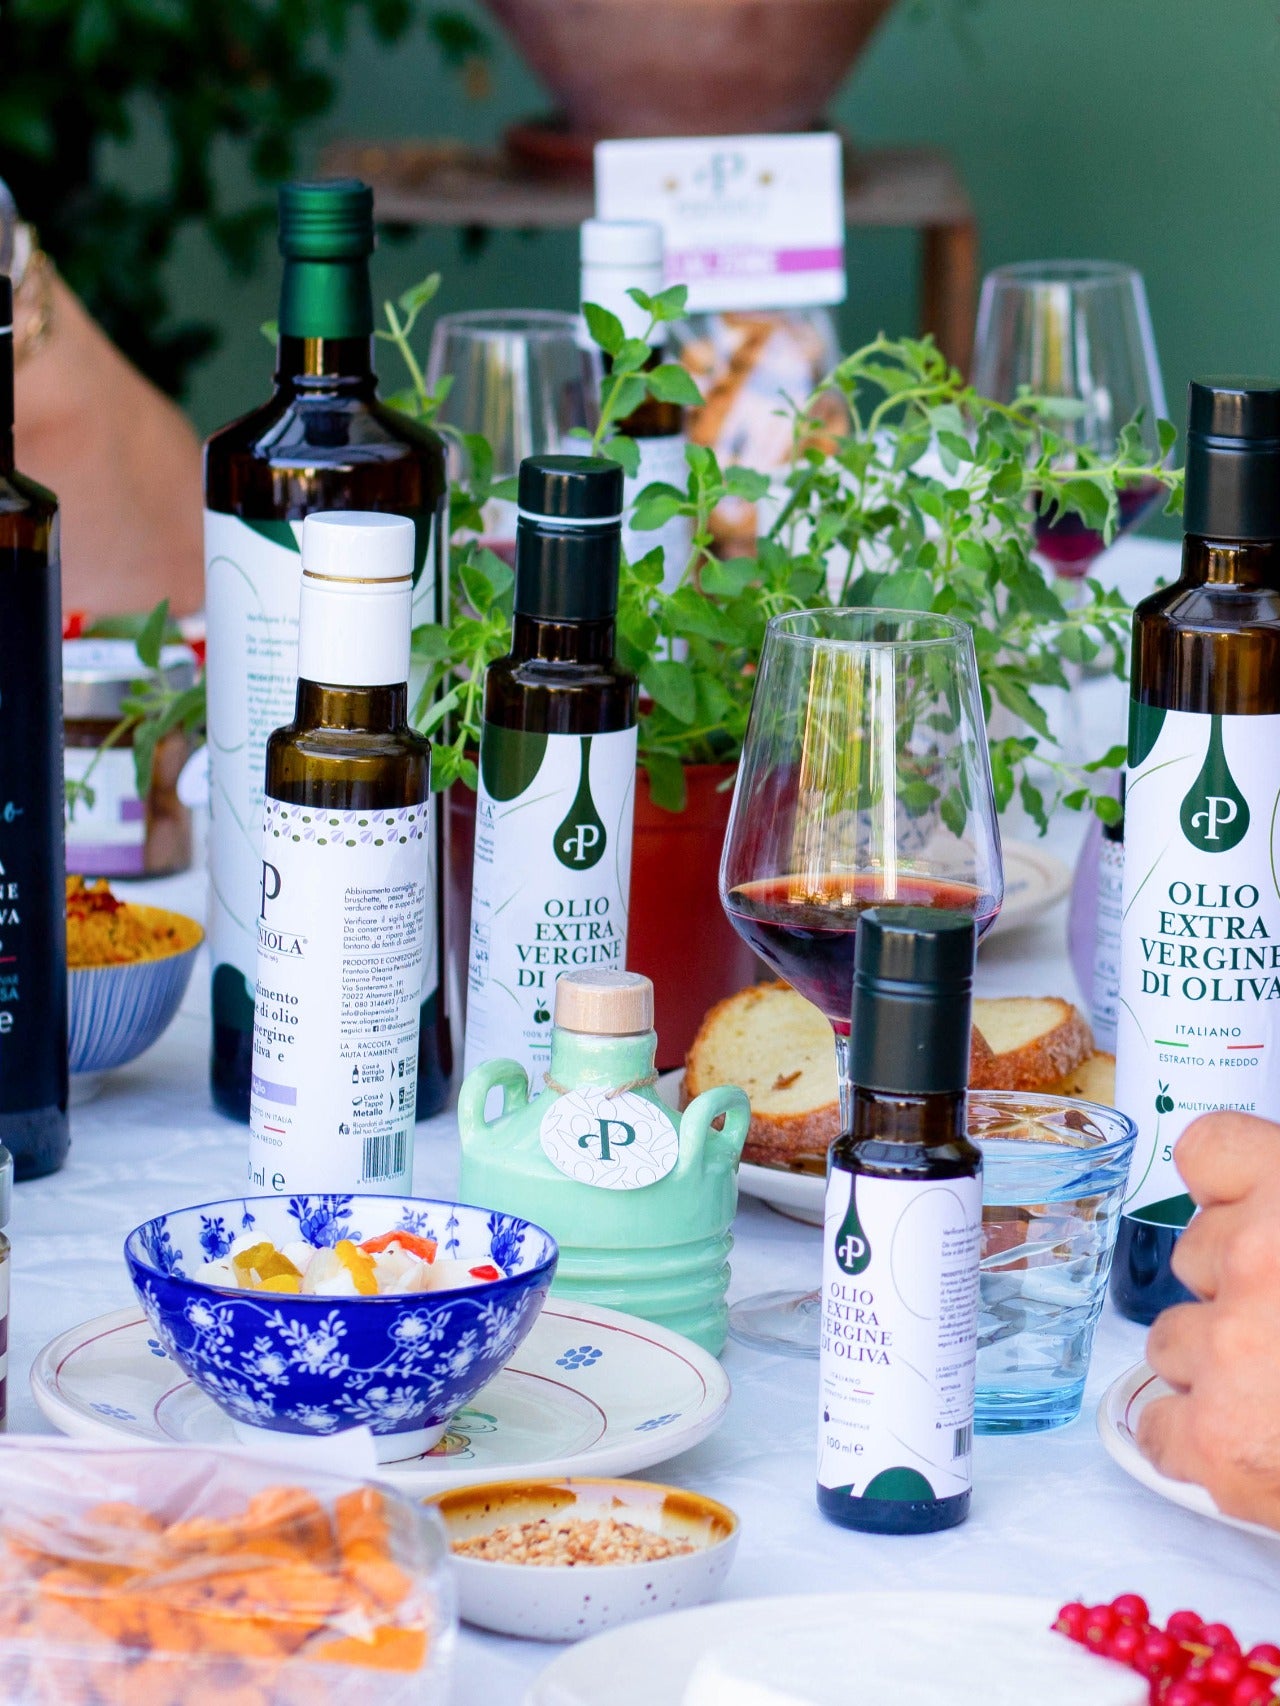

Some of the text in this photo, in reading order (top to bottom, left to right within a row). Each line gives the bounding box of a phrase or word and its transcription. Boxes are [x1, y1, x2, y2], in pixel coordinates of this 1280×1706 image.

[1191, 796, 1238, 840] P
[562, 824, 600, 861] P
[344, 895, 381, 903] bruschette,
[387, 894, 404, 903] pesce
[345, 887, 390, 895] Abbinamento
[1168, 881, 1260, 909] OLIO
[544, 896, 609, 918] OLIO
[344, 917, 377, 925] Verificare
[358, 925, 393, 933] conservare
[1158, 910, 1271, 940] EXTRA
[535, 920, 614, 941] EXTRA
[343, 941, 369, 949] lontano
[371, 941, 380, 949] da
[516, 938, 621, 965] VERGINE
[518, 968, 545, 989] DI
[1141, 969, 1172, 998] DI
[260, 1002, 298, 1025] di olio
[1175, 1024, 1241, 1037] ITALIANO
[357, 1040, 391, 1049] RACCOLTA
[363, 1047, 398, 1057] L'AMBIENTE
[278, 1052, 284, 1061] e
[1159, 1053, 1259, 1067] ESTRATTO A FREDDO
[362, 1075, 384, 1083] VETRO
[364, 1100, 383, 1108] Tappo
[1178, 1101, 1256, 1111] MULTIVARIETALE
[265, 1111, 271, 1120] IN
[272, 1114, 293, 1125] ITALIA
[353, 1108, 383, 1117] Metallo
[260, 1135, 283, 1147] FREDDO
[578, 1118, 636, 1162] P
[838, 1235, 866, 1268] P
[831, 1282, 874, 1306] OLIO
[826, 1299, 879, 1327] EXTRA
[834, 1341, 890, 1366] OLIVA
[826, 1435, 840, 1450] 100
[841, 1443, 852, 1454] ml
